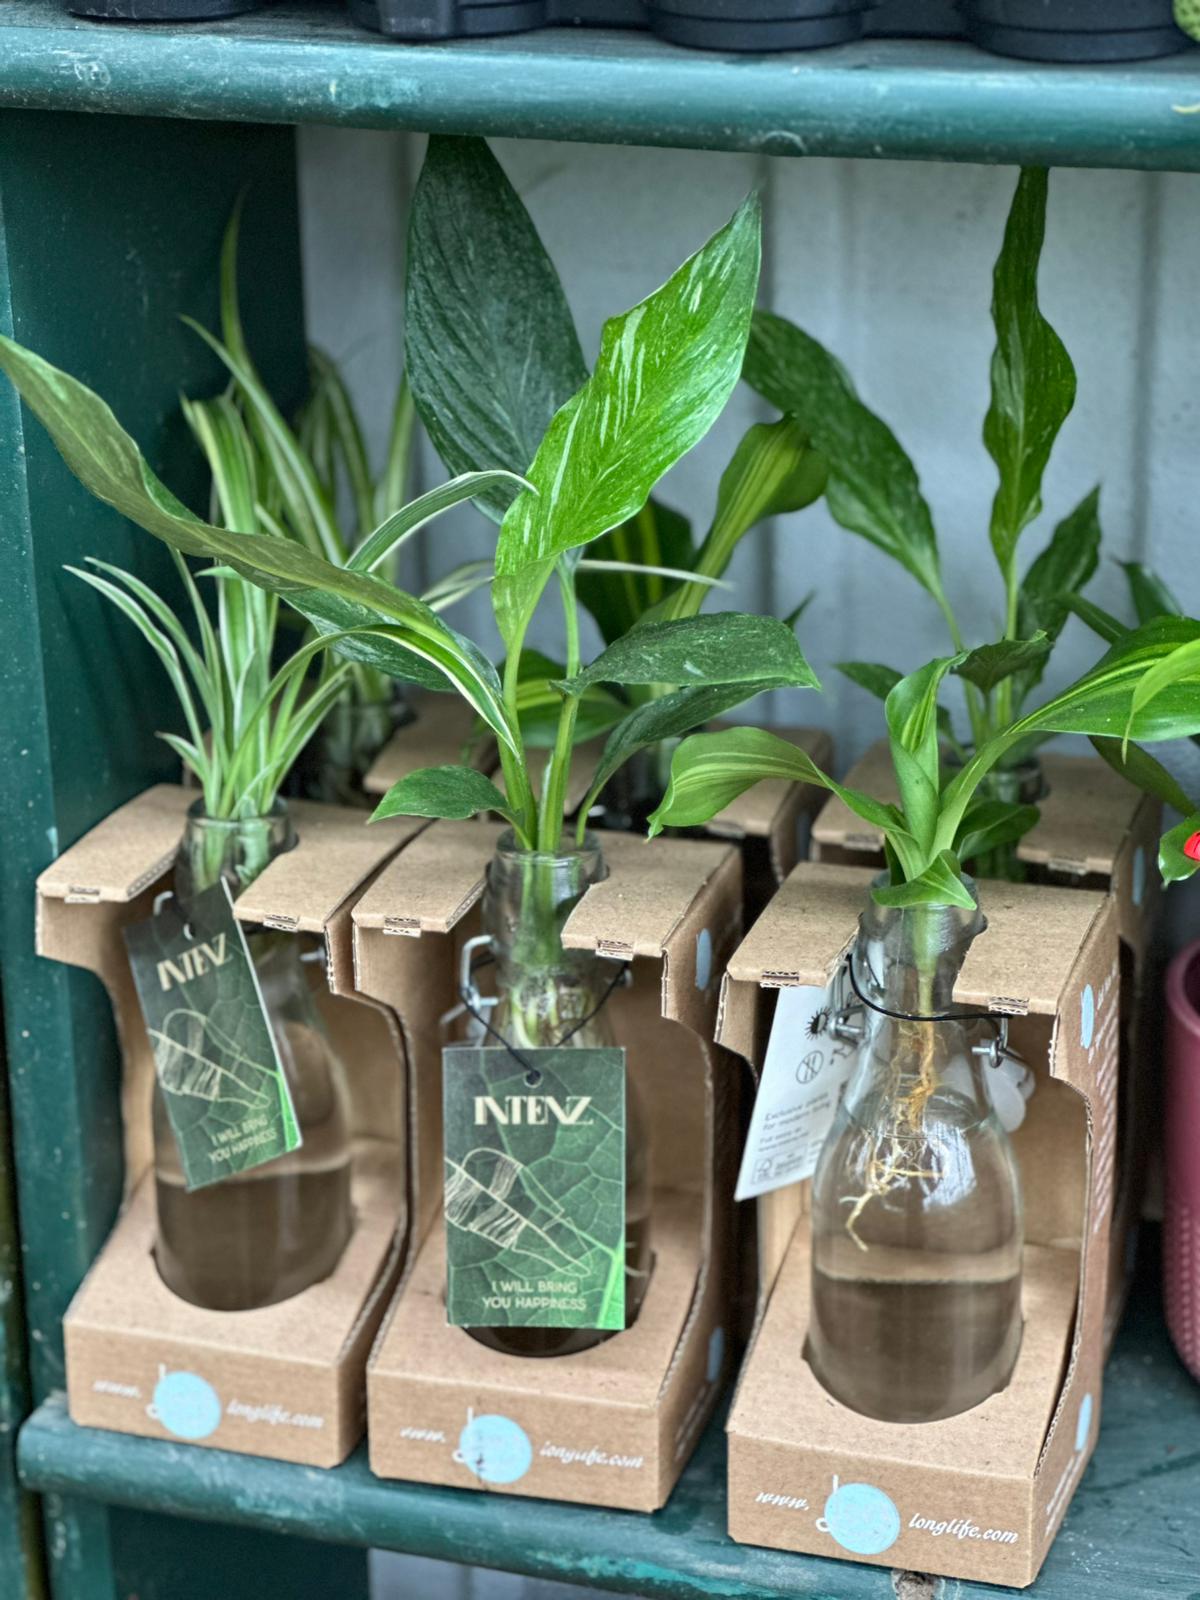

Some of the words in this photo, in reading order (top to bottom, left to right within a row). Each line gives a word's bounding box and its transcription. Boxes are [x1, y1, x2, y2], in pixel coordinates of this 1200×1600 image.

[474, 1095, 594, 1125] INTENZ
[208, 1146, 231, 1164] YOU
[492, 1281, 498, 1292] I
[500, 1281, 534, 1293] WILL
[538, 1281, 578, 1294] BRING
[482, 1297, 511, 1309] YOU
[515, 1297, 587, 1311] HAPPINESS
[908, 1512, 1019, 1544] longlife.com
